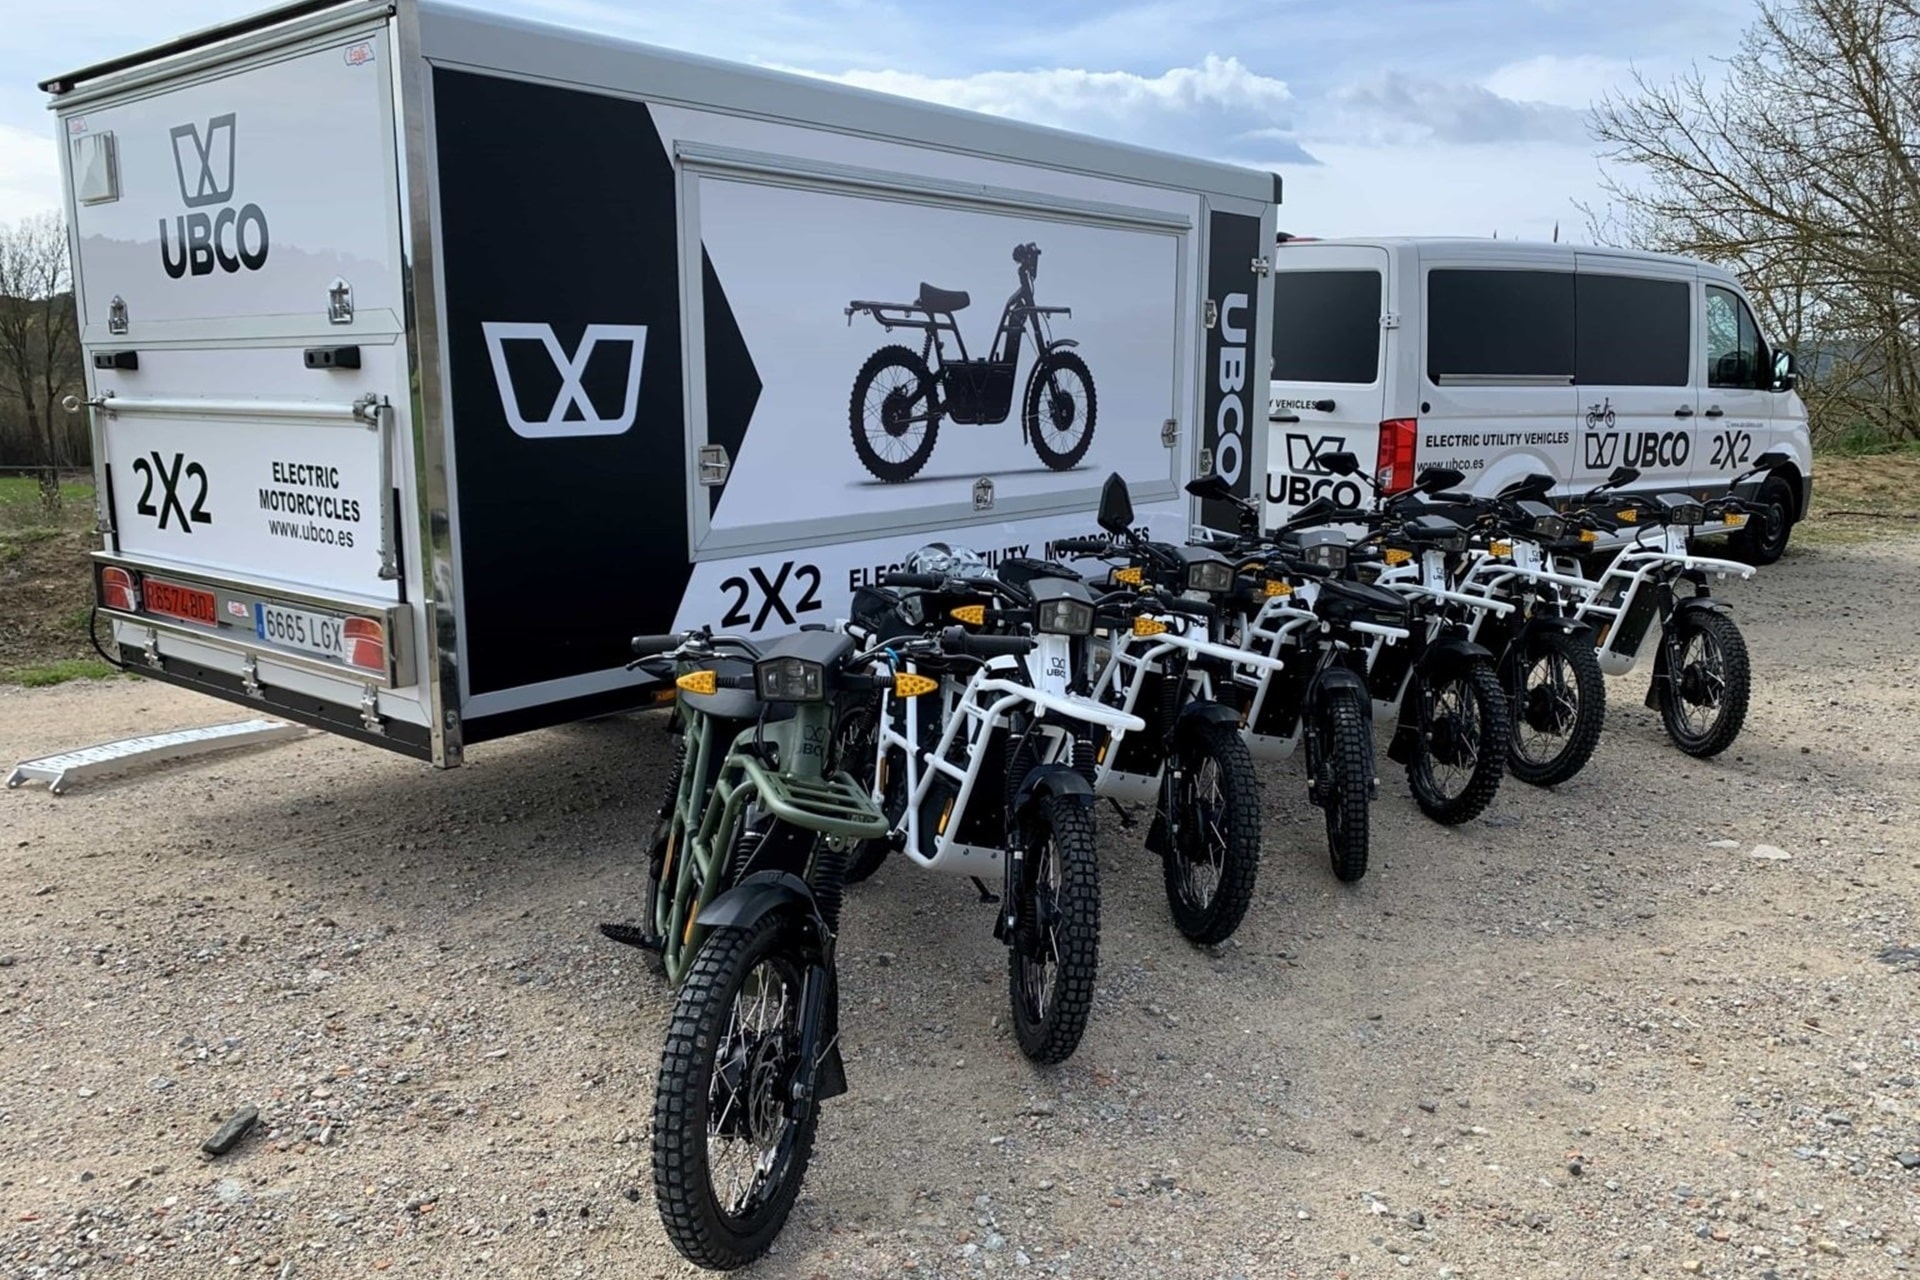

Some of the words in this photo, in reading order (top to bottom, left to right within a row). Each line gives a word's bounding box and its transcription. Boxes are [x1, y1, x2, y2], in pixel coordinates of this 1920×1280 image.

[159, 203, 269, 279] UBCO
[1215, 292, 1248, 486] UBCO
[1276, 399, 1317, 410] VEHICLES
[1425, 433, 1480, 448] ELECTRIC
[1482, 433, 1522, 447] UTILITY
[1524, 431, 1569, 445] VEHICLES
[1623, 431, 1690, 467] UBCO
[272, 461, 340, 489] ELECTRIC
[1417, 457, 1484, 472] wwwubco.es
[259, 488, 361, 523] MOTORCYCLES
[1266, 473, 1361, 510] UBCO
[268, 519, 354, 548] www.ubco.es
[266, 610, 306, 644] 6665
[310, 617, 343, 652] LGX
